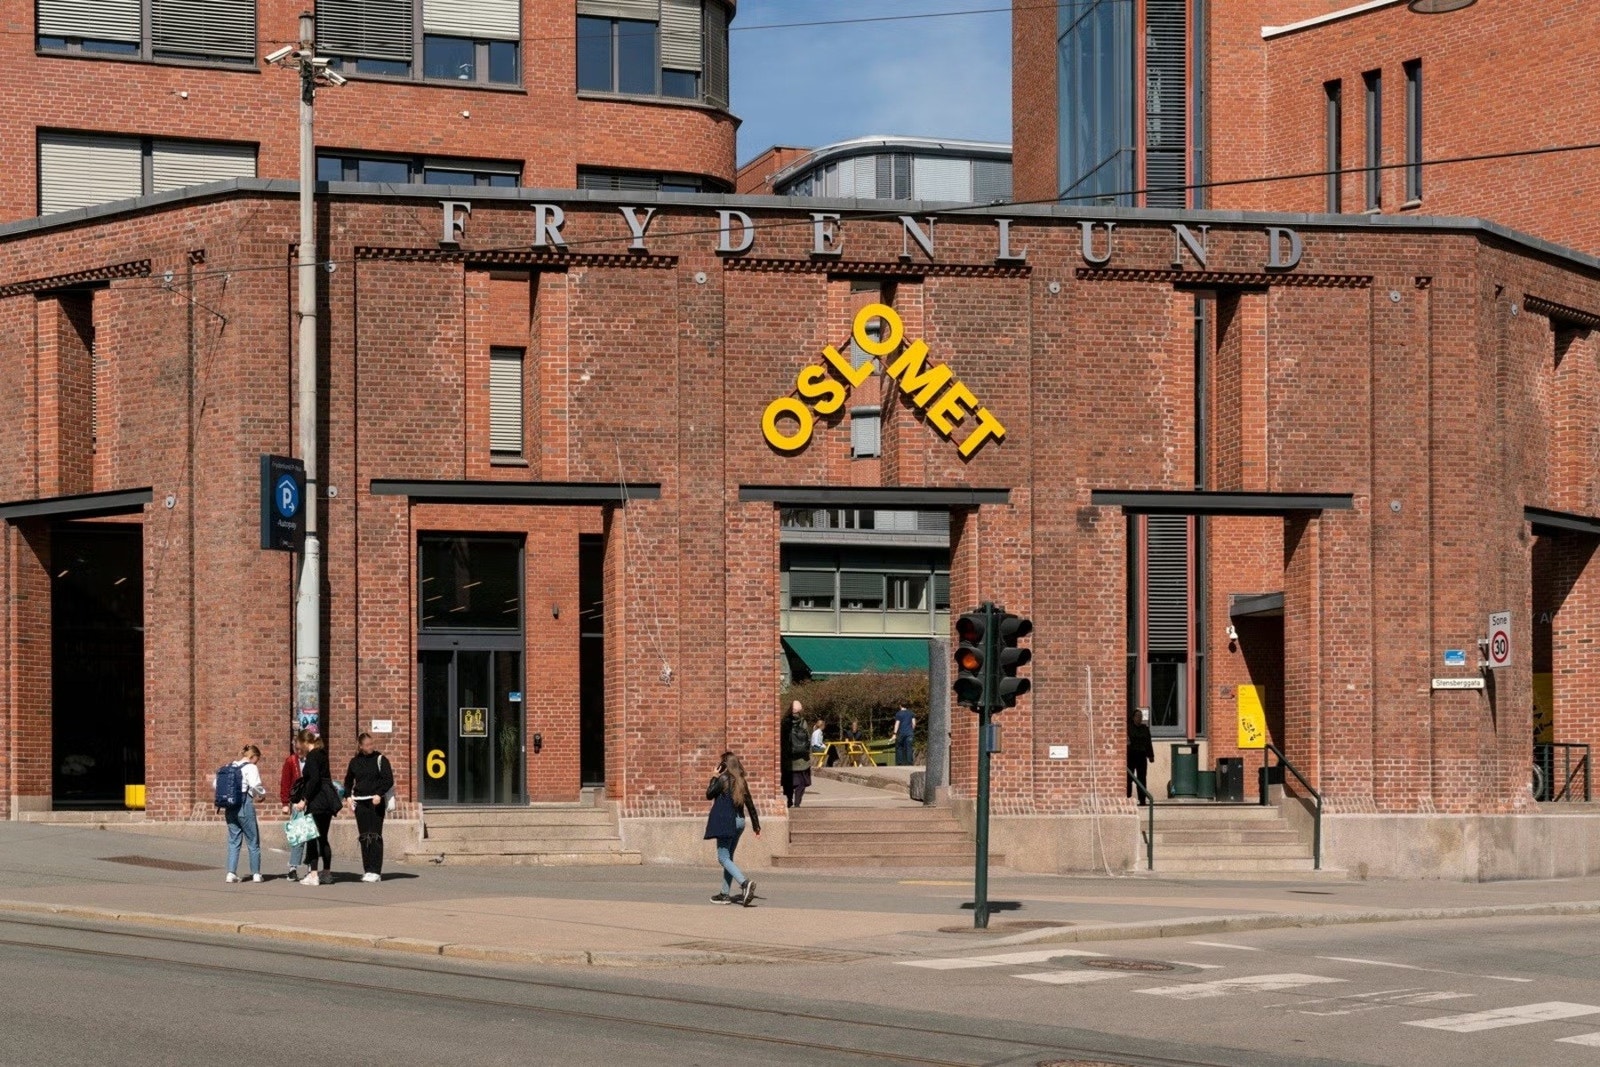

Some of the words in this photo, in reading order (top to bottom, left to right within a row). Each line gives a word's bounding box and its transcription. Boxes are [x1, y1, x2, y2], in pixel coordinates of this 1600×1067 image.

[437, 199, 1304, 271] FRYDENLUND
[1492, 616, 1507, 626] Sone
[1494, 639, 1506, 655] 30
[1435, 679, 1481, 688] Stensberggata
[426, 749, 446, 779] 6
